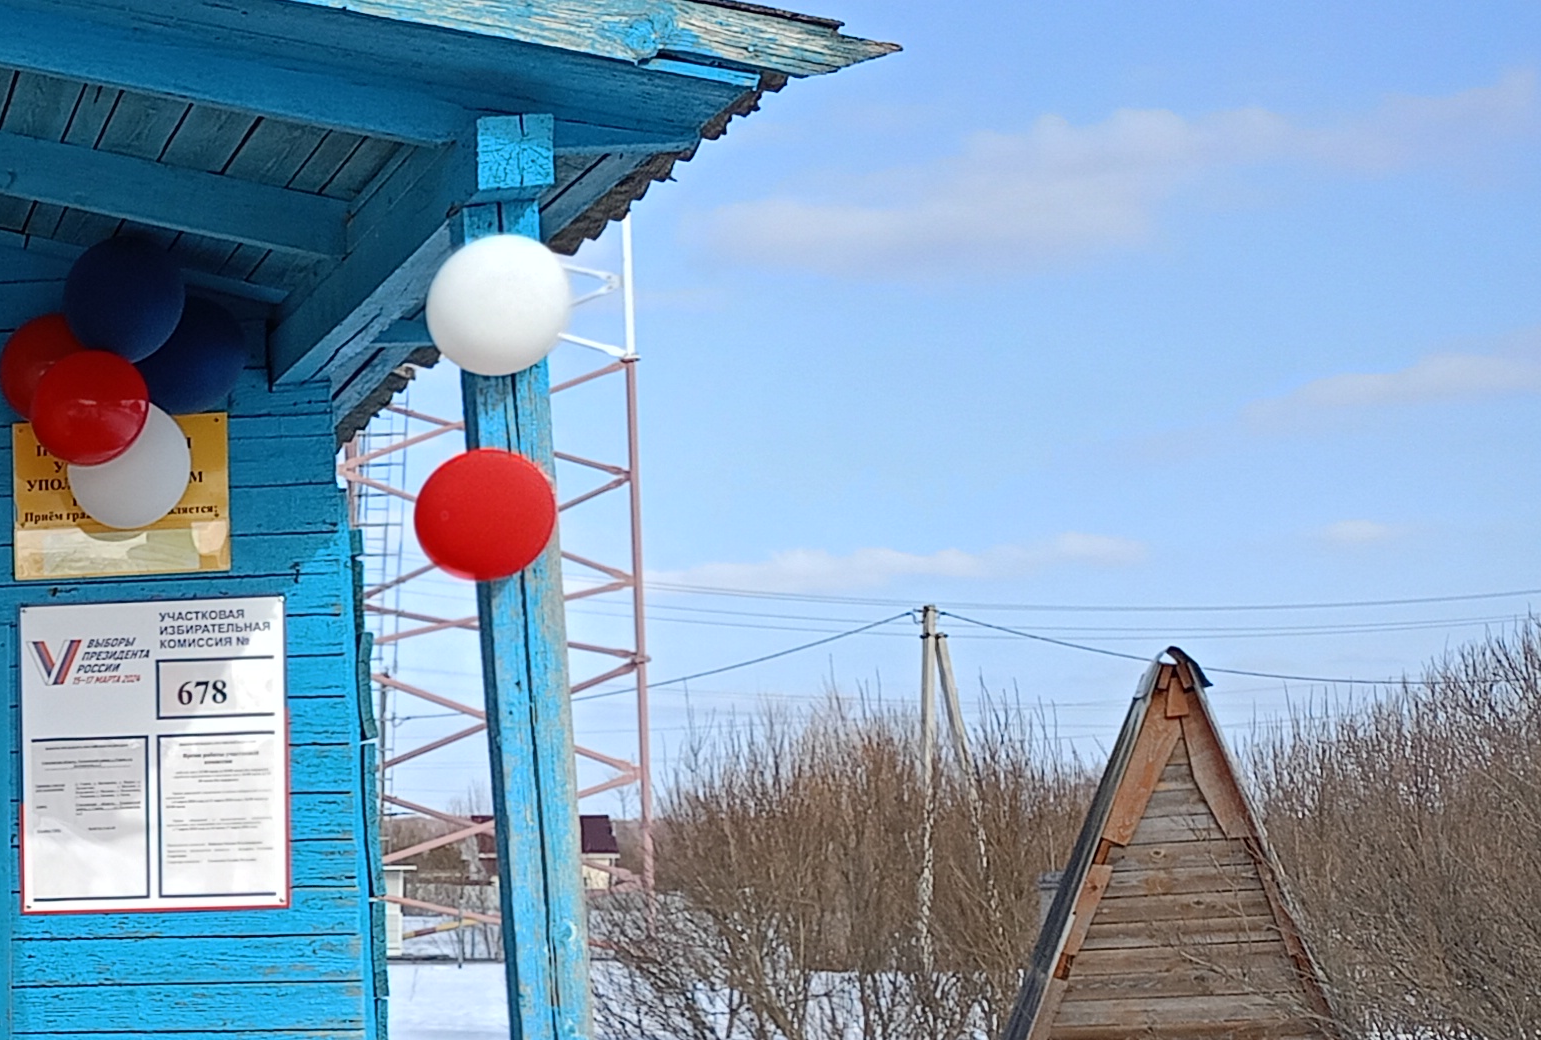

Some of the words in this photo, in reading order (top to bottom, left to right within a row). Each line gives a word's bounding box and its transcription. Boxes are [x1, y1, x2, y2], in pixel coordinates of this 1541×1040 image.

[159, 609, 245, 623] УЧАСТКОВАЯ
[159, 621, 271, 636] ИЗБИРАТЕЛЬНАЯ
[87, 637, 136, 649] ВЫБОРЫ
[159, 637, 233, 649] КОМИССИЯ
[81, 649, 150, 661] ПРЕЗИДЕНТА
[76, 663, 121, 674] РОССИИ
[177, 680, 228, 705] 678
